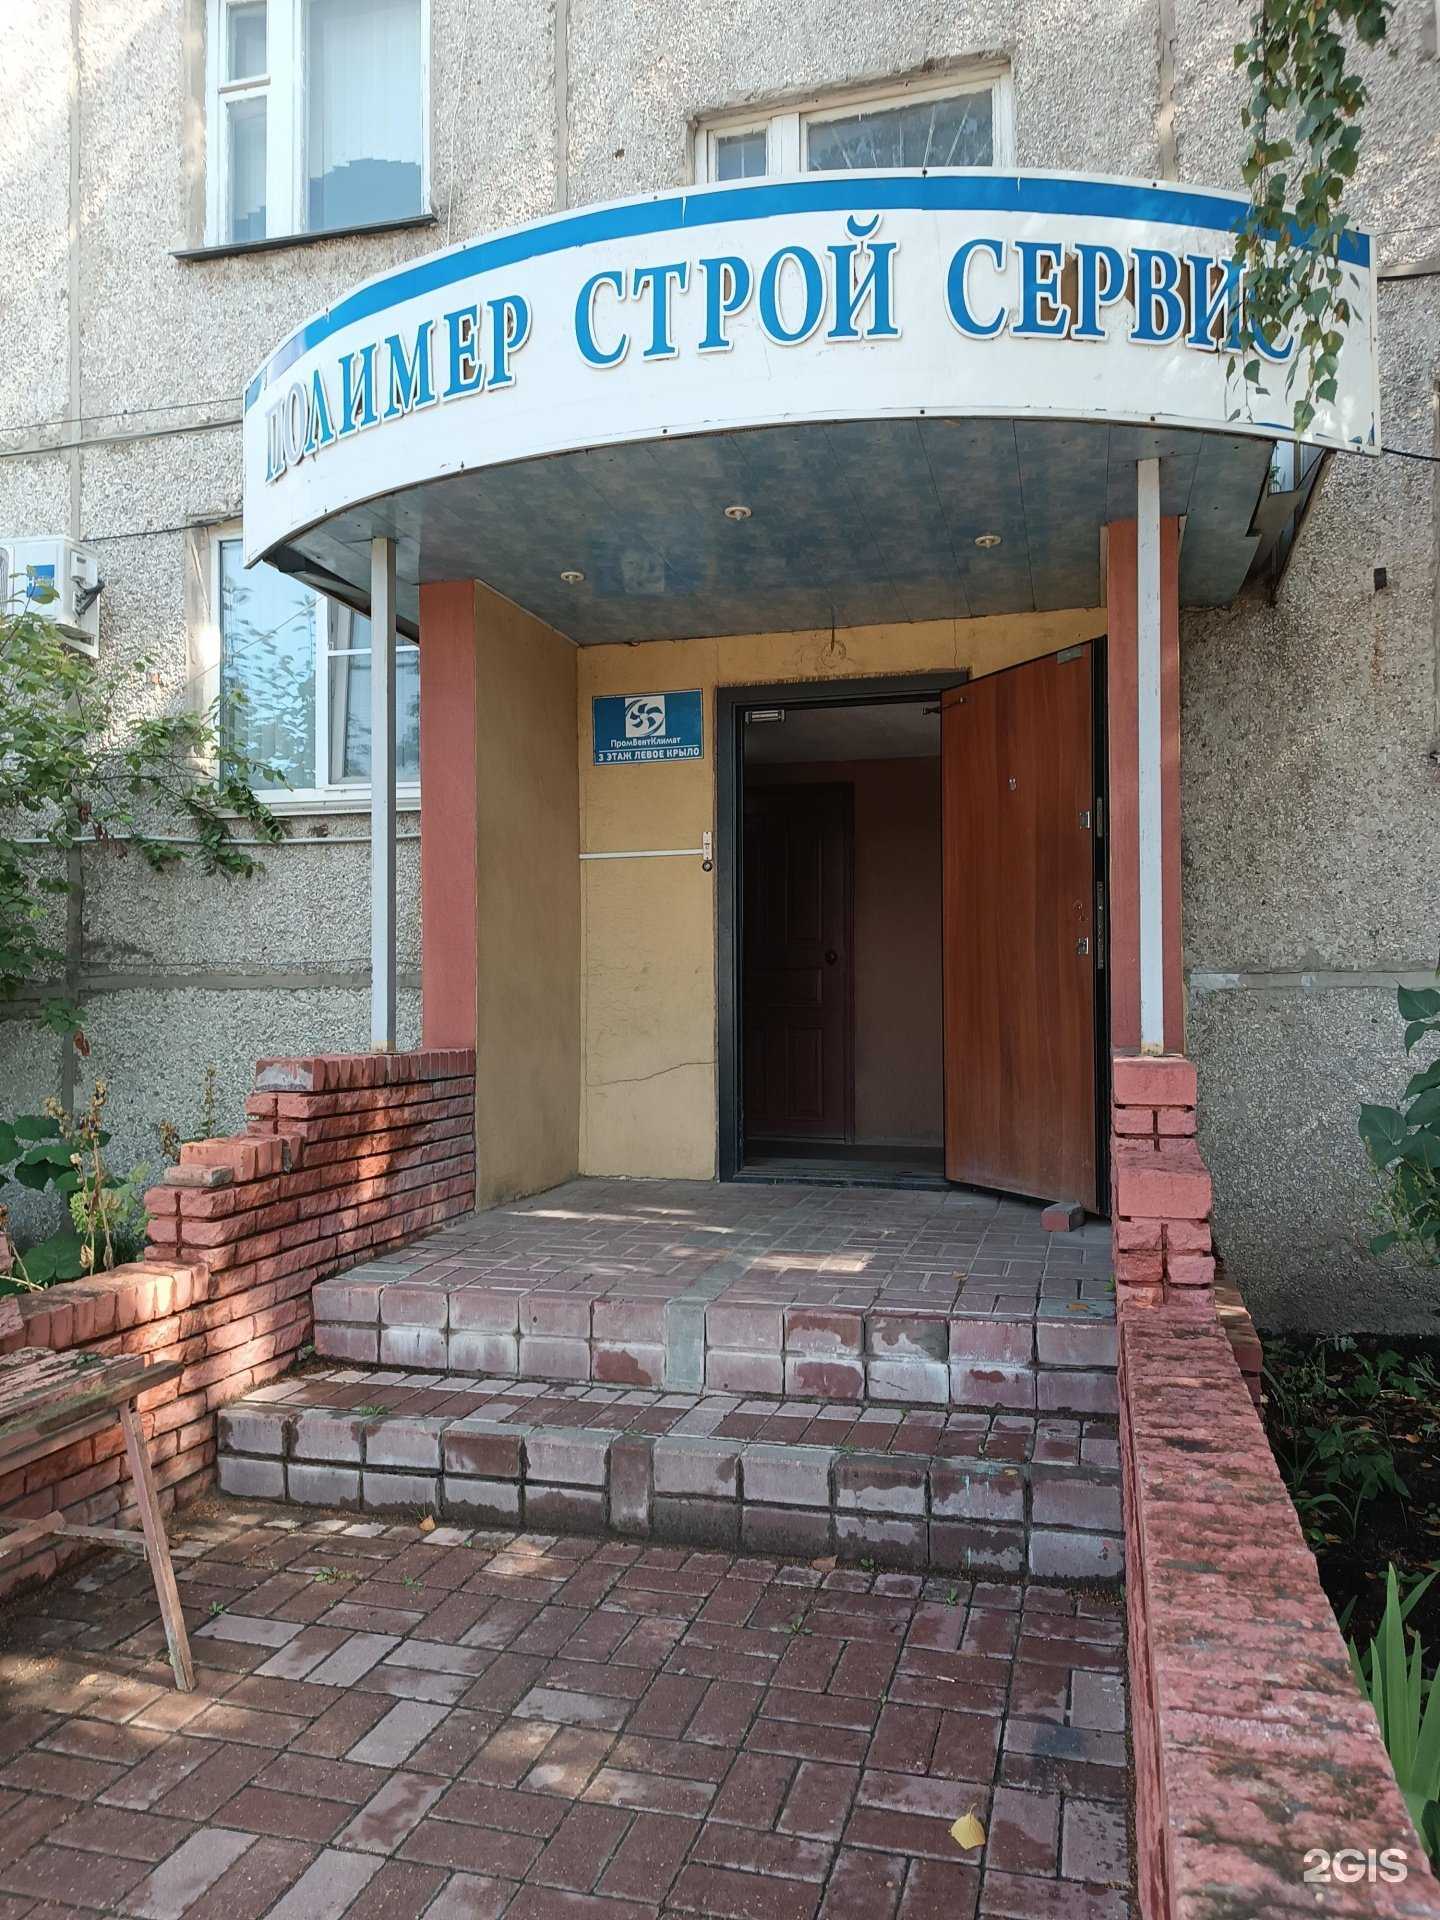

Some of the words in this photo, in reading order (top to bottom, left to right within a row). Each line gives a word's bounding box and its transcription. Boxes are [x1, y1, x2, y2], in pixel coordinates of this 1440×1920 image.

[264, 293, 531, 485] ПОЛИМЕР
[574, 212, 902, 368] СТРОЙ
[610, 736, 681, 749] ПромВентКлимат
[598, 753, 604, 762] 3
[606, 752, 632, 761] ЭТАЖ
[634, 749, 665, 760] ЛЕВОЕ
[666, 747, 700, 758] КРЫЛО
